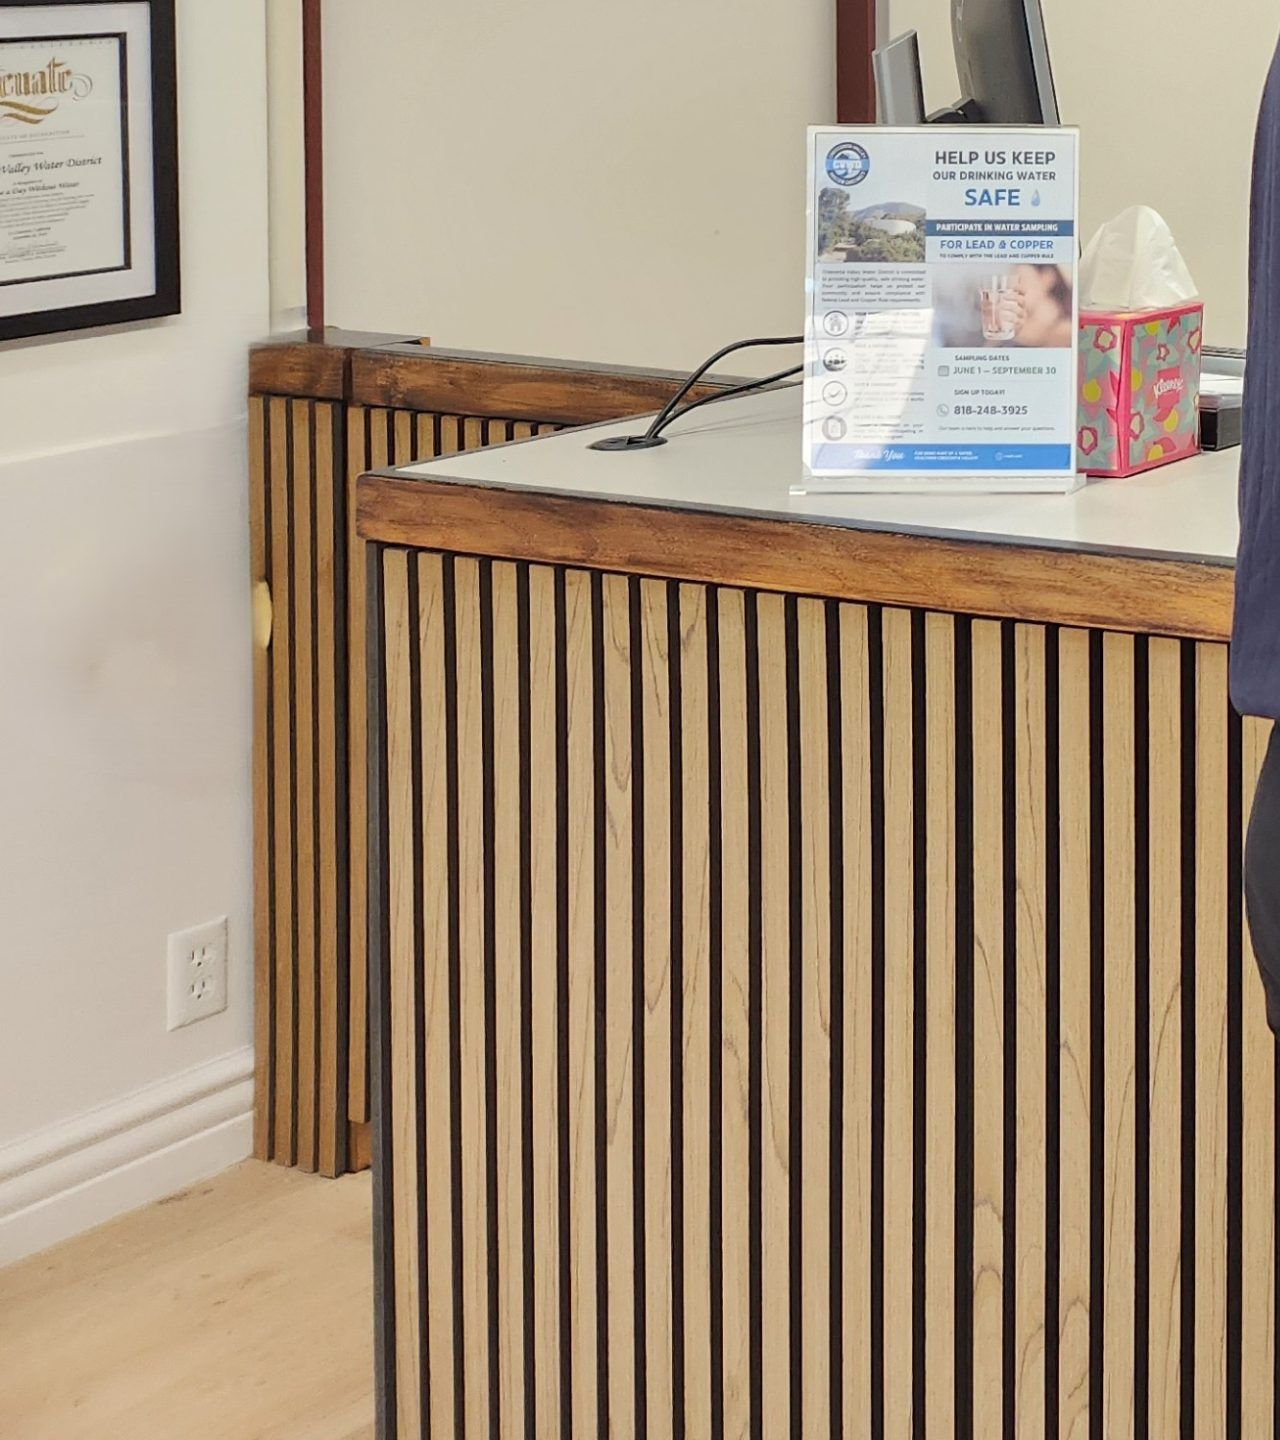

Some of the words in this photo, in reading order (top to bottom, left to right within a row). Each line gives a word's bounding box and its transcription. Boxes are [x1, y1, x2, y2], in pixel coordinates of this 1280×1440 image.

[935, 151, 979, 165] HELP
[985, 151, 1006, 165] US
[1012, 151, 1056, 165] KEEP
[1, 162, 31, 176] Valley
[34, 160, 64, 171] Water
[66, 157, 102, 167] District
[932, 171, 956, 180] OUR
[960, 171, 1014, 180] DRINKING
[1017, 171, 1056, 180] WATER
[964, 188, 1020, 206] SAFE
[936, 223, 983, 231] PARTICIPATE
[984, 223, 993, 231] IN
[994, 223, 1020, 231] WATER
[1020, 223, 1058, 231] SAMPLING
[940, 240, 962, 249] FOR
[966, 240, 995, 249] LEAD
[998, 240, 1006, 249] &
[1010, 240, 1054, 249] COPPER
[953, 366, 975, 375] JUNE
[992, 366, 1043, 375] SEPTEMBER
[1046, 366, 1056, 374] 30
[1153, 378, 1184, 398] Kleenex
[954, 405, 1028, 415] 818-248-3925
